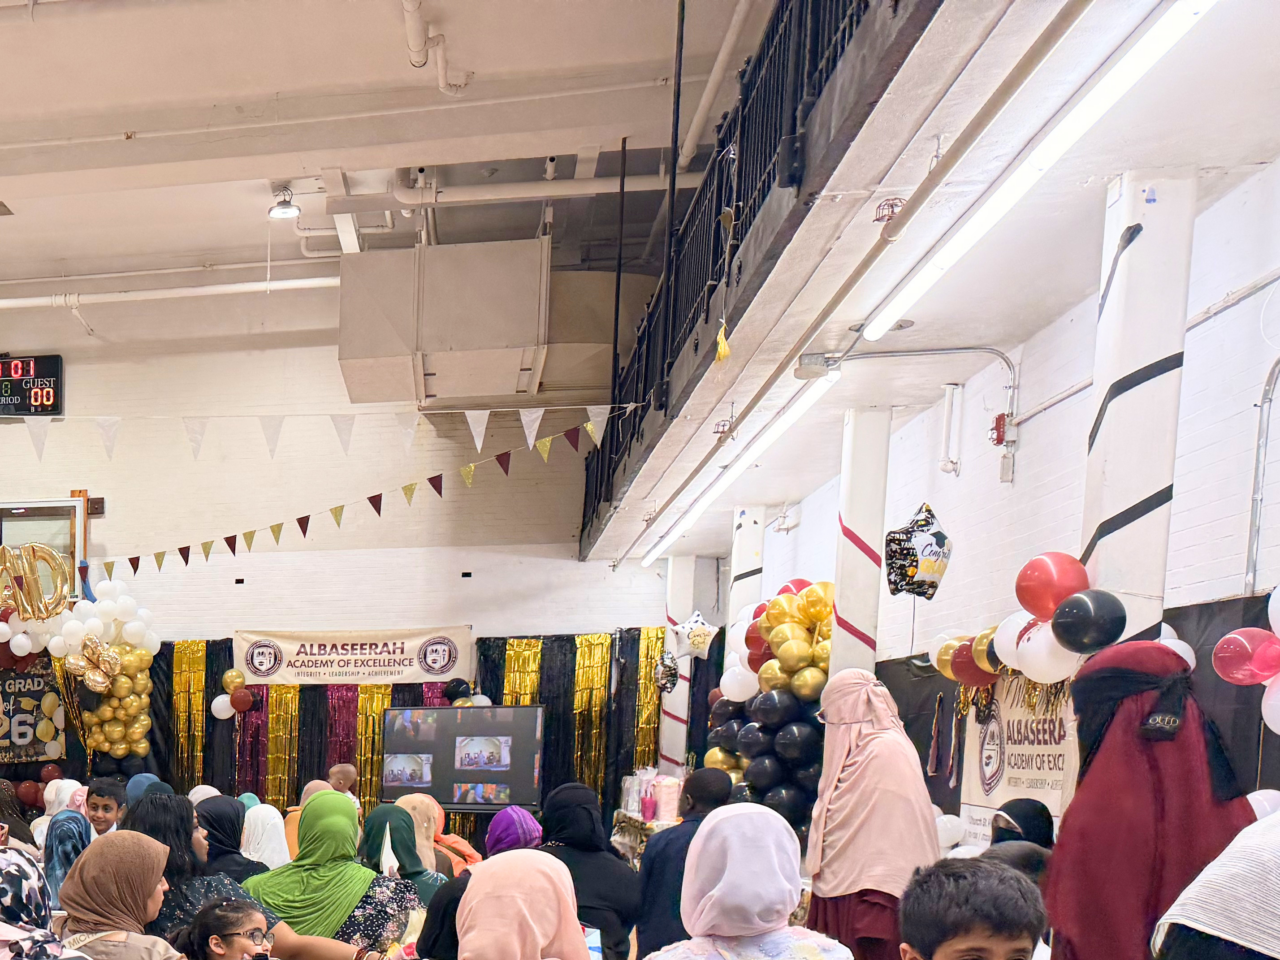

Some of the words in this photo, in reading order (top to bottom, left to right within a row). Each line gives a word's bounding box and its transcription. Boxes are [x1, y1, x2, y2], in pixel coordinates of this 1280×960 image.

[22, 378, 56, 389] GUEST
[31, 388, 54, 405] 00
[296, 641, 405, 656] ALBASEERAH
[286, 659, 335, 669] ACADEMY
[337, 659, 352, 668] OF
[354, 657, 414, 668] EXCELLENCE
[367, 669, 404, 677] ACHIEVEMENT
[5, 678, 45, 693] GRAD
[3, 695, 16, 716] of
[1007, 752, 1034, 770] ACADEMY
[1035, 753, 1045, 770] OF
